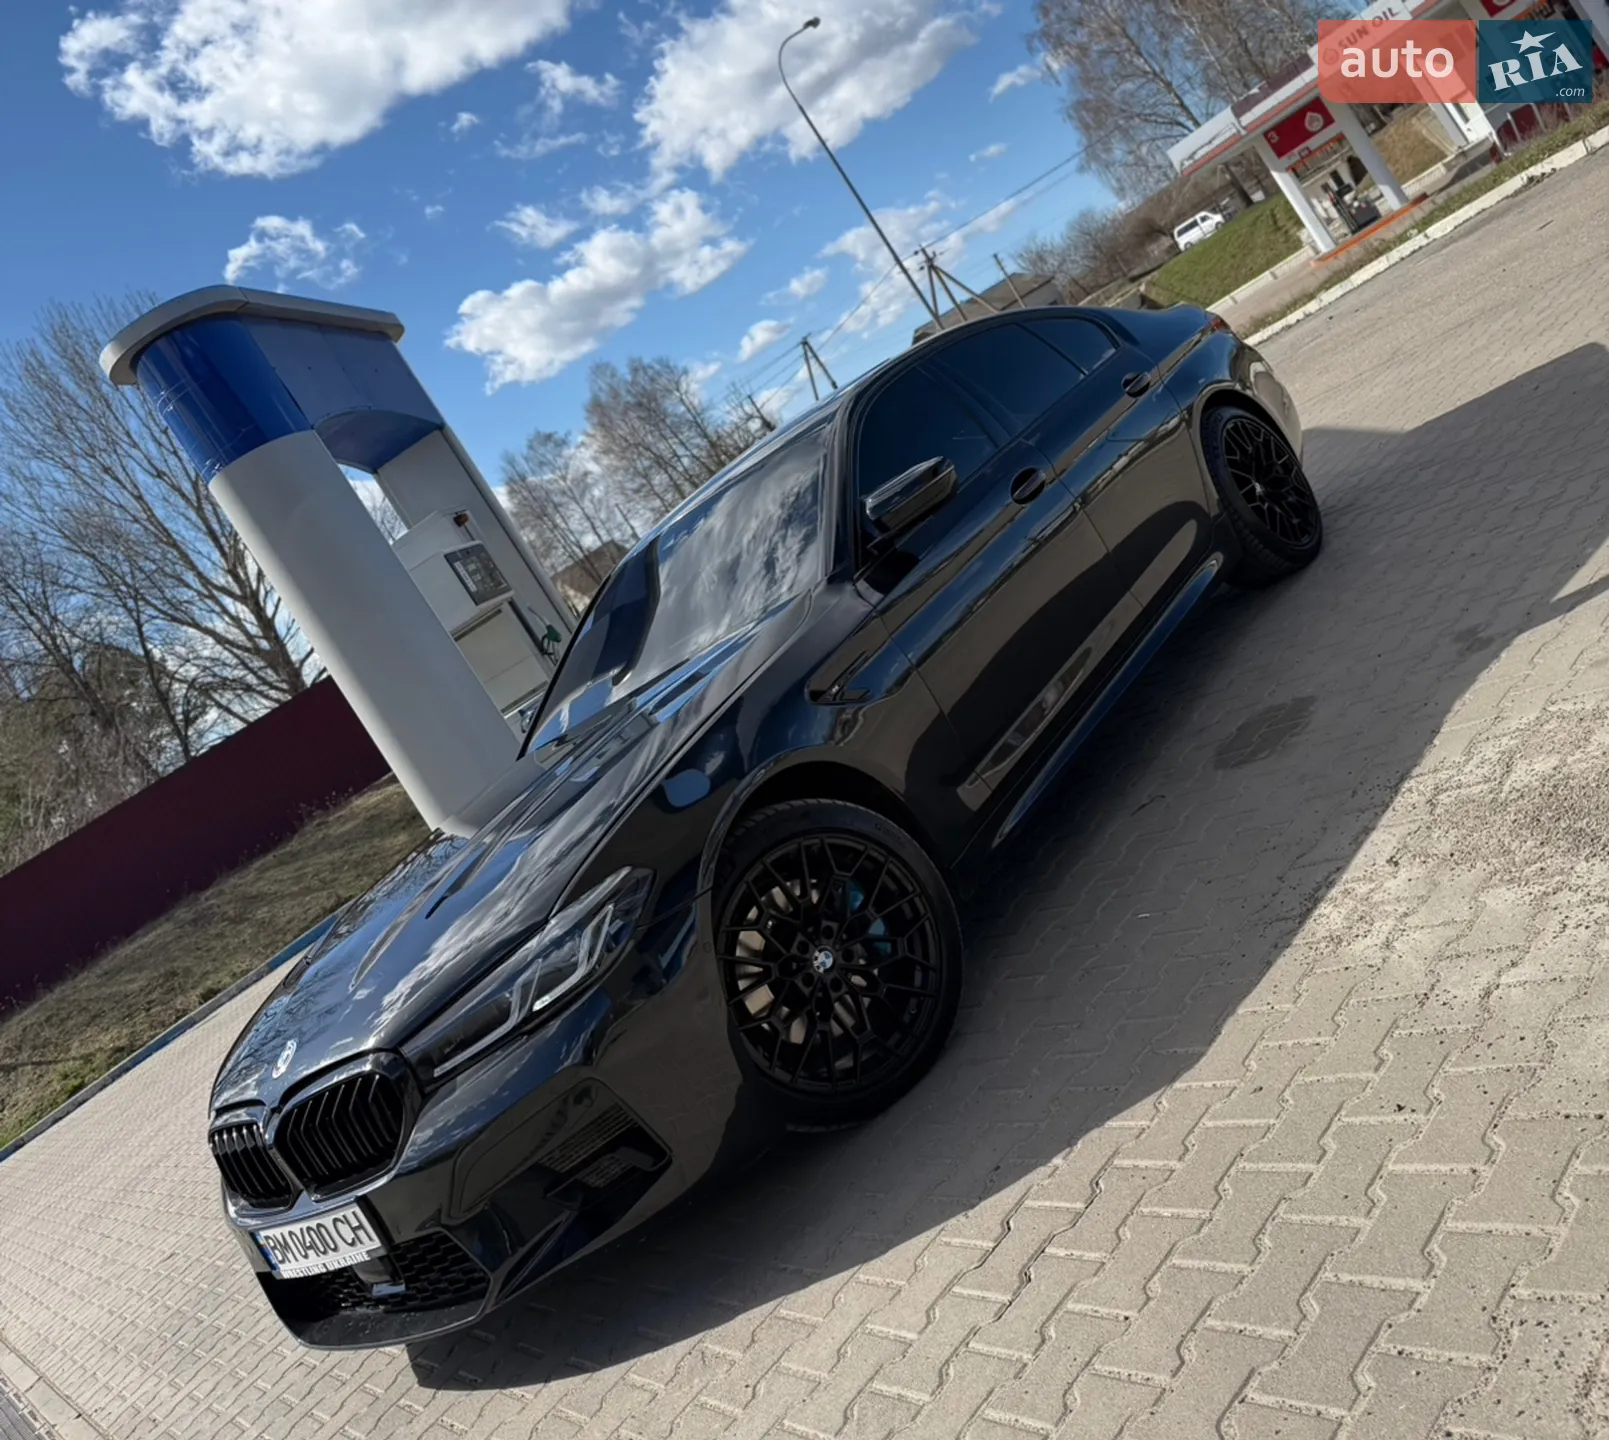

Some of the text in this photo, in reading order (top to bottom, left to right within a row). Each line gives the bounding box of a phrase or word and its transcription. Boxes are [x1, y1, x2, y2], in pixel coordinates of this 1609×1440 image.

[1339, 7, 1399, 51] SUN OIL
[263, 1231, 299, 1265] BM
[288, 1223, 338, 1260] 0400
[333, 1211, 375, 1248] CH
